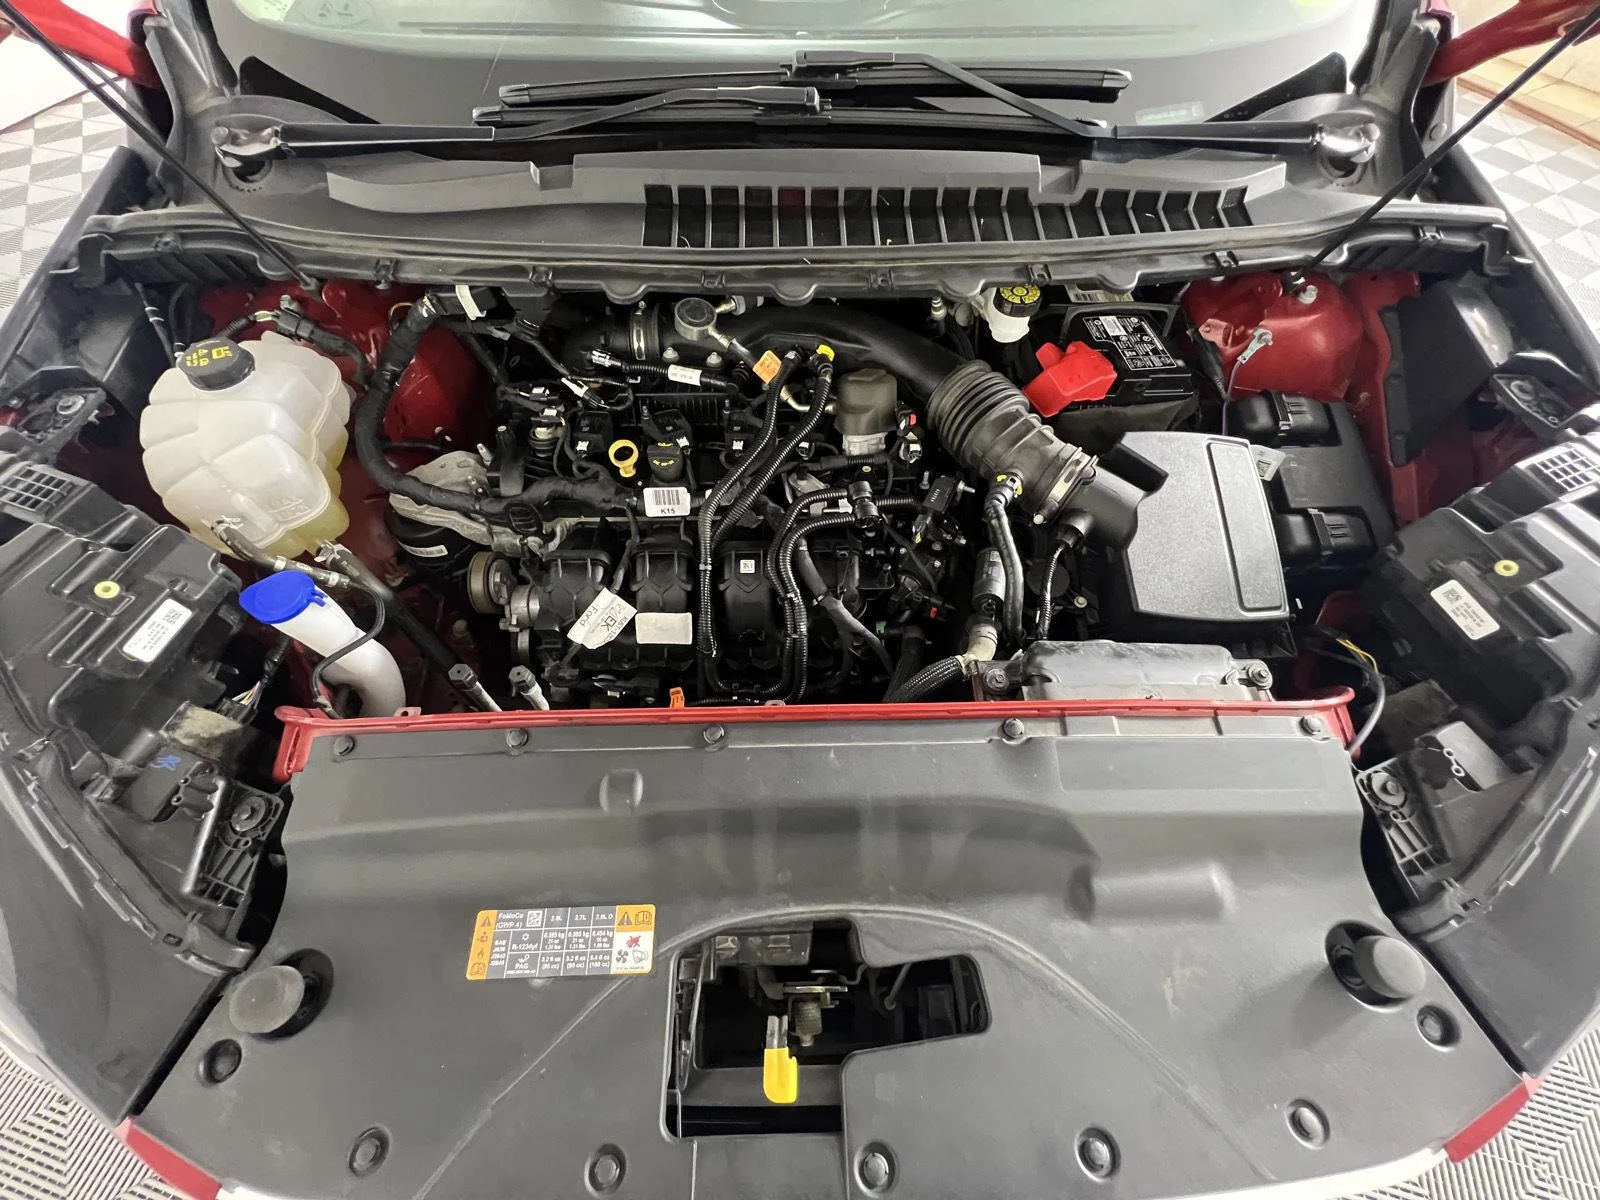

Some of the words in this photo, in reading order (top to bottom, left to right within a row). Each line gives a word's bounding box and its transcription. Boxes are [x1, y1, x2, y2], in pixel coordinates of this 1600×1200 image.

[580, 606, 598, 626] Ford
[496, 921, 514, 930] (GWP
[515, 921, 523, 930] 4)
[512, 943, 539, 951] R-1234yf
